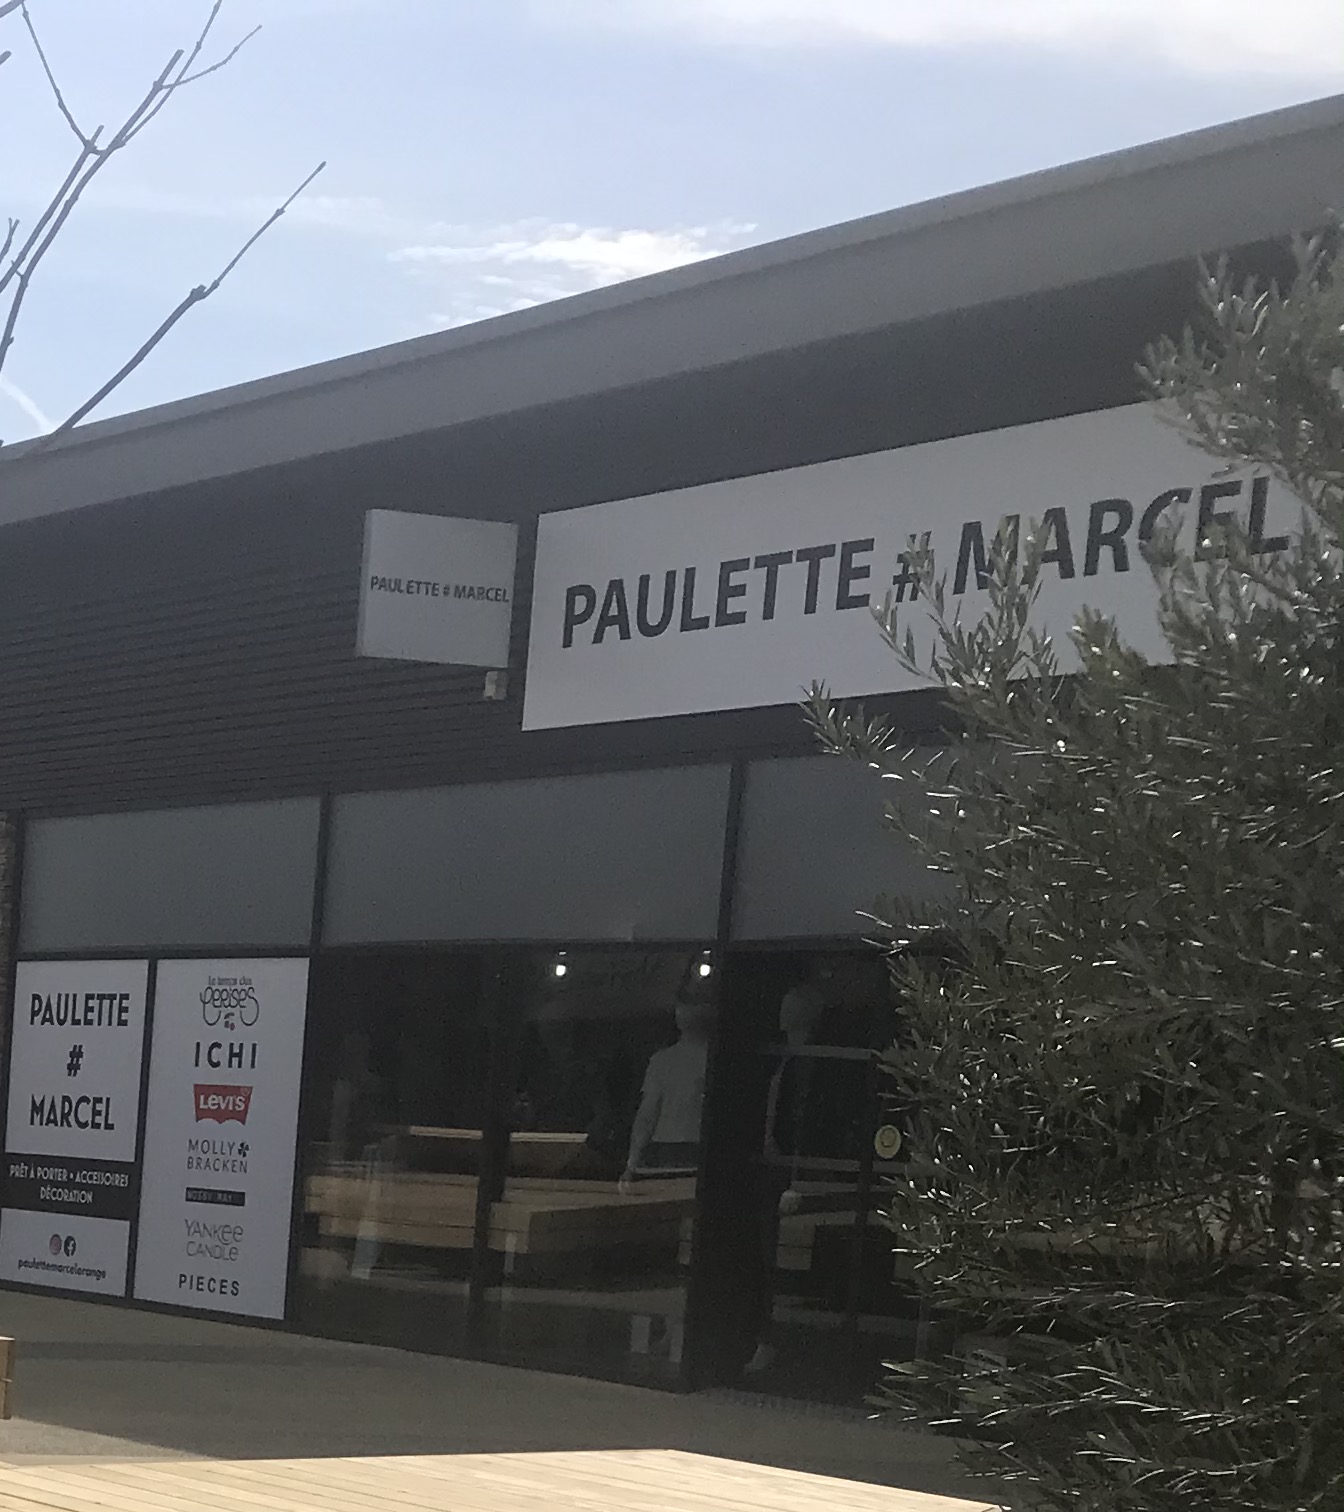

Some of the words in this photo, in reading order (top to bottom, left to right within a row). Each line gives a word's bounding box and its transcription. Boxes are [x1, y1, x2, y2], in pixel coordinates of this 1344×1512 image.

[370, 575, 440, 597] PAULETTE
[453, 584, 510, 603] MARCEL
[562, 537, 876, 648] PAULETTE
[29, 992, 130, 1027] PAULETTE
[66, 1044, 84, 1077] #
[194, 1041, 258, 1069] ICHI
[29, 1093, 115, 1131] MARCEL
[187, 1138, 236, 1156] MOLLY
[36, 1166, 68, 1182] PORTER
[74, 1170, 129, 1188] ACCESSOIRES
[186, 1156, 248, 1174] BRACKEN
[39, 1184, 93, 1204] DÉCORATION
[178, 1273, 240, 1297] PIECES
